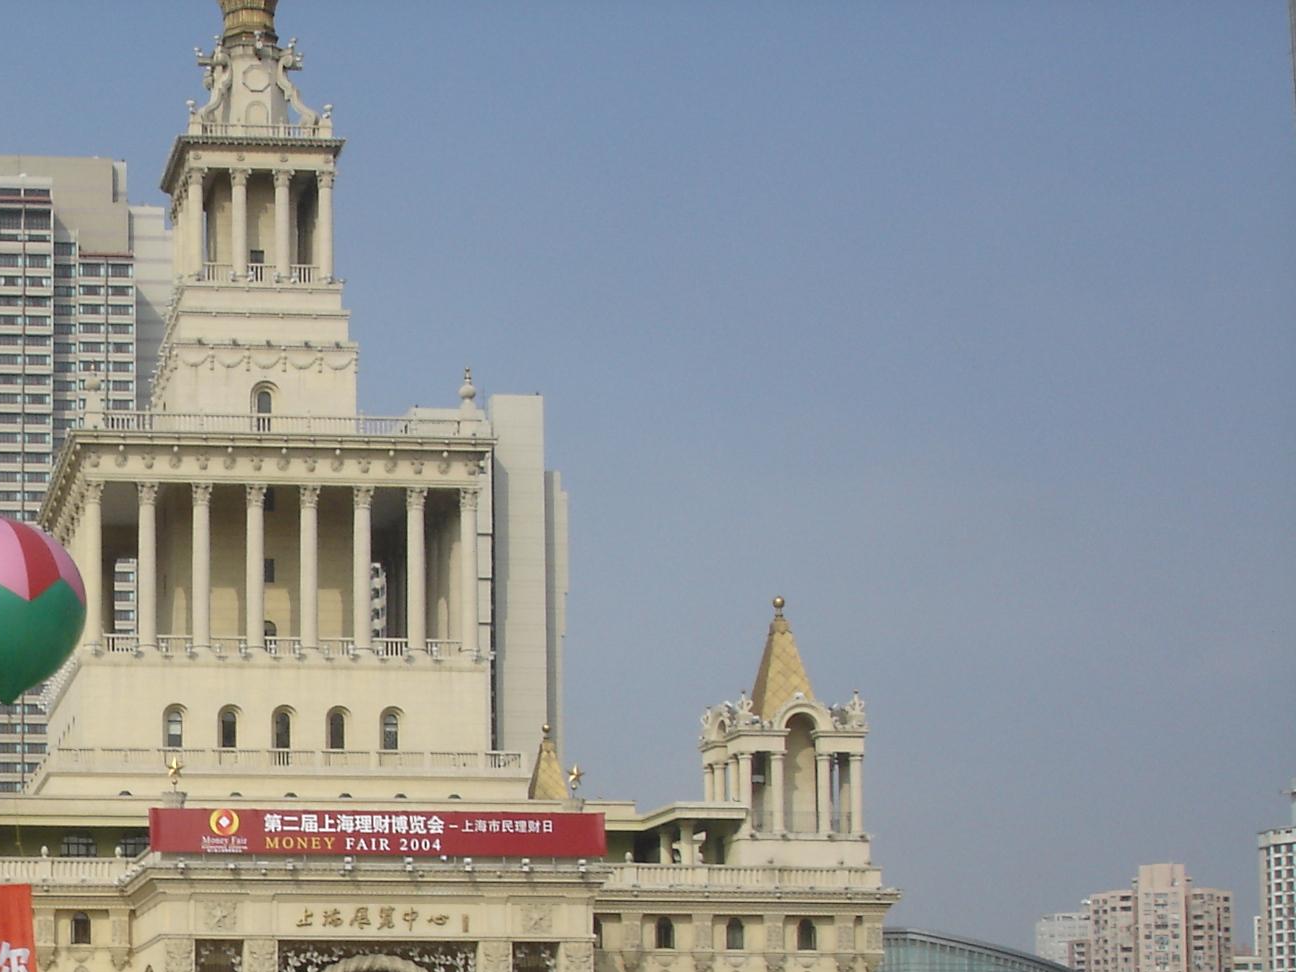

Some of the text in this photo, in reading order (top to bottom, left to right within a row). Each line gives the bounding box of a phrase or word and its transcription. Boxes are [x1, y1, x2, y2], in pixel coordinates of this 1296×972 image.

[264, 813, 445, 834] 第二届上海理财博览会
[461, 819, 553, 833] 上海市民理财日
[265, 837, 442, 851] MONEY FAIR 2004
